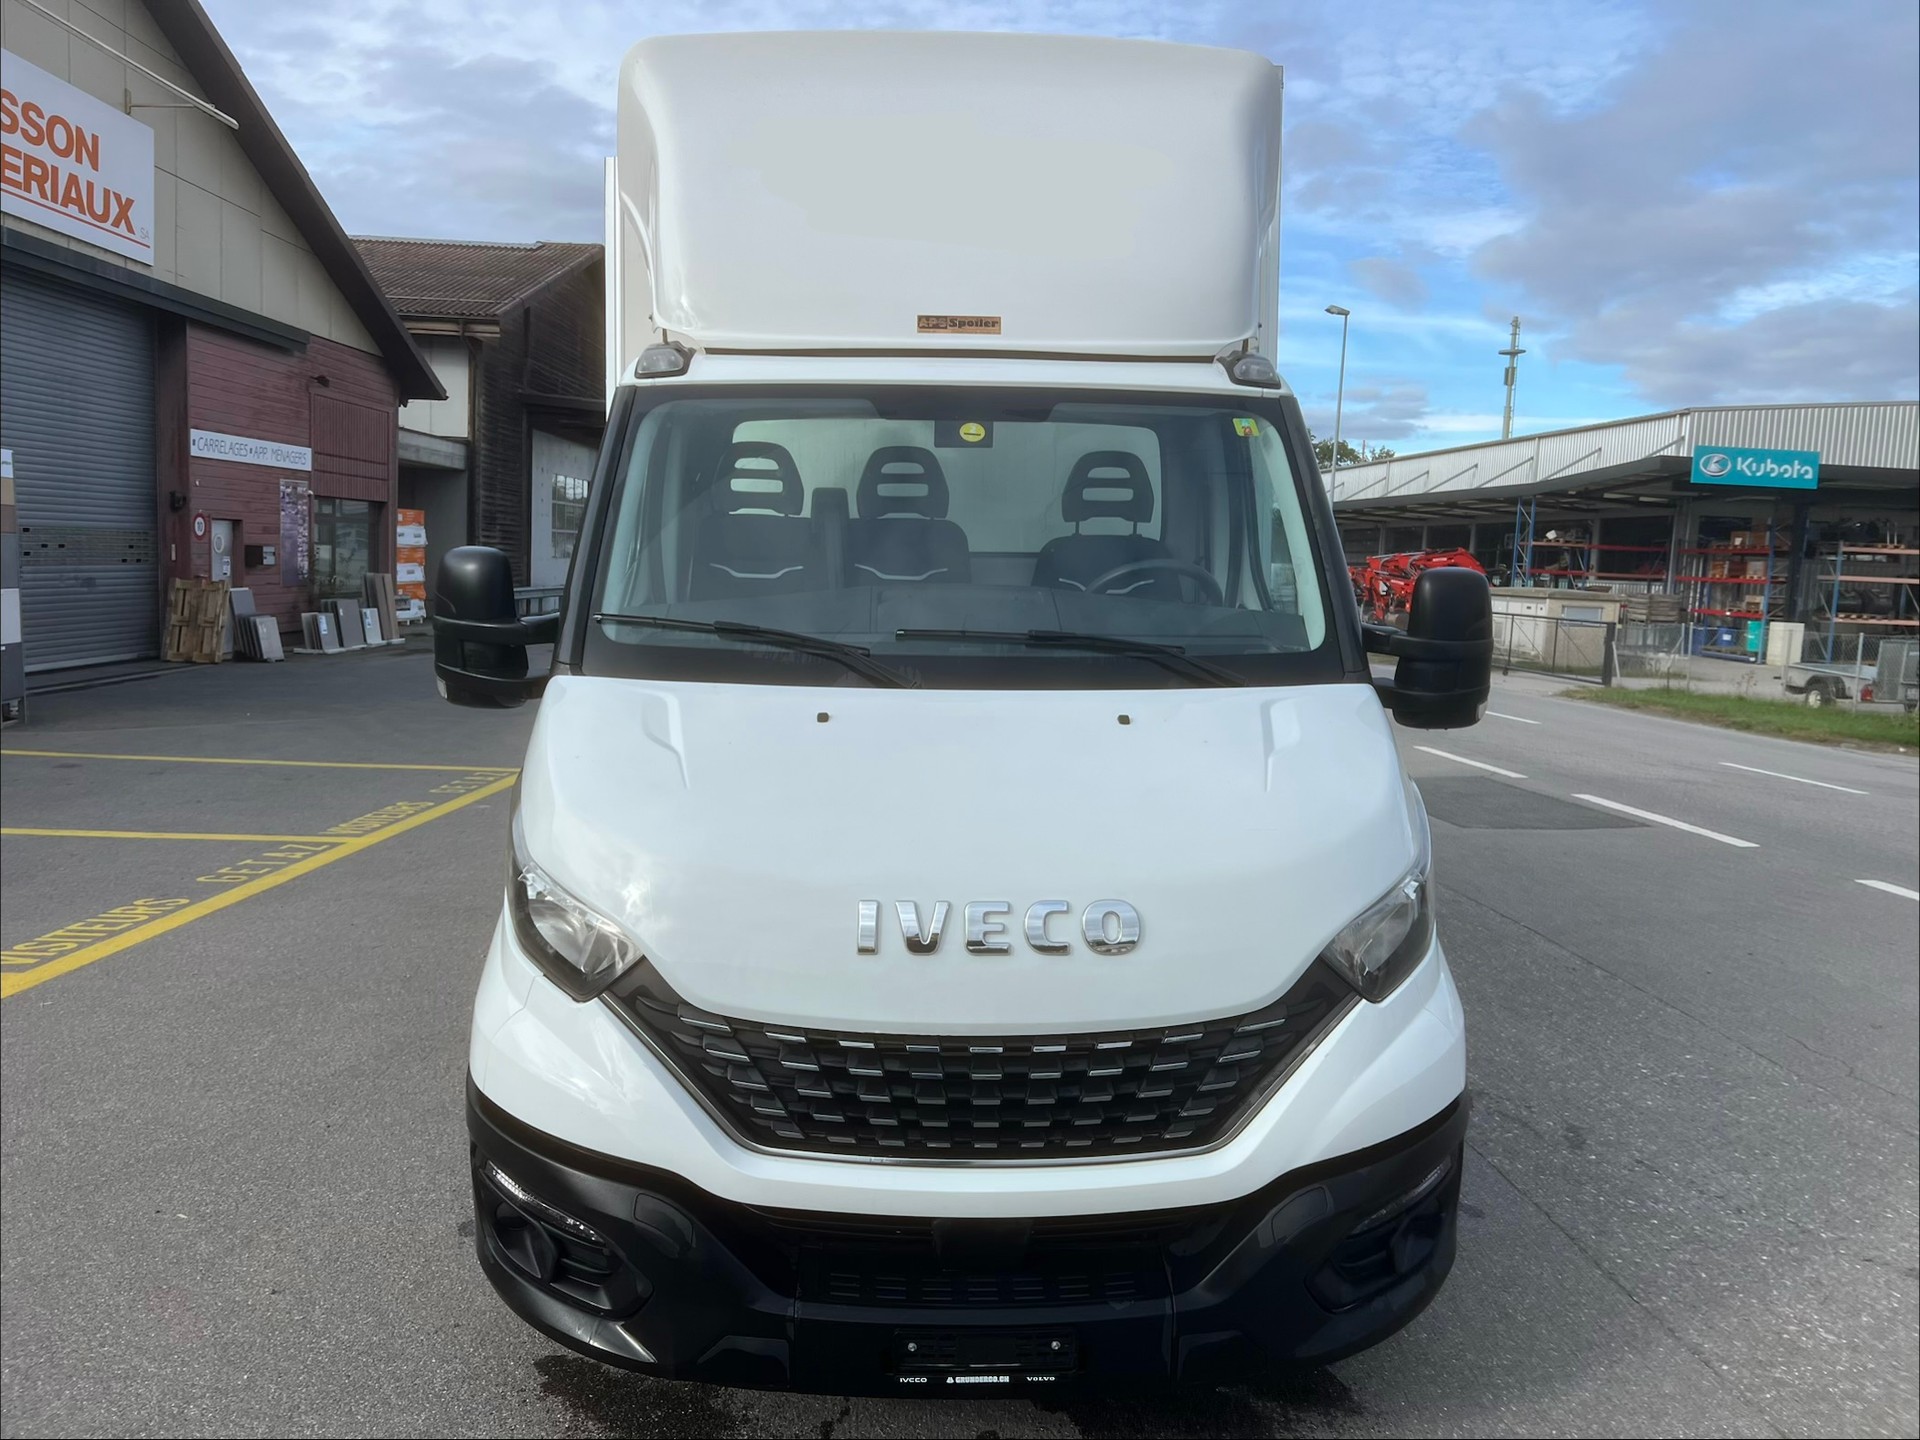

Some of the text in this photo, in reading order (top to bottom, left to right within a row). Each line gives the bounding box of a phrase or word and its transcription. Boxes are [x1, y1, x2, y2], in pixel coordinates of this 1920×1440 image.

[1, 88, 100, 172] SSON
[1, 142, 136, 235] ERIAUX
[948, 318, 999, 329] Spoiler
[197, 437, 248, 458] CARRELAGES
[1736, 456, 1814, 480] Kubota
[319, 801, 435, 835] VISITEURS
[1, 843, 331, 965] VISITEURS GETAZ
[856, 898, 1142, 956] IVECO
